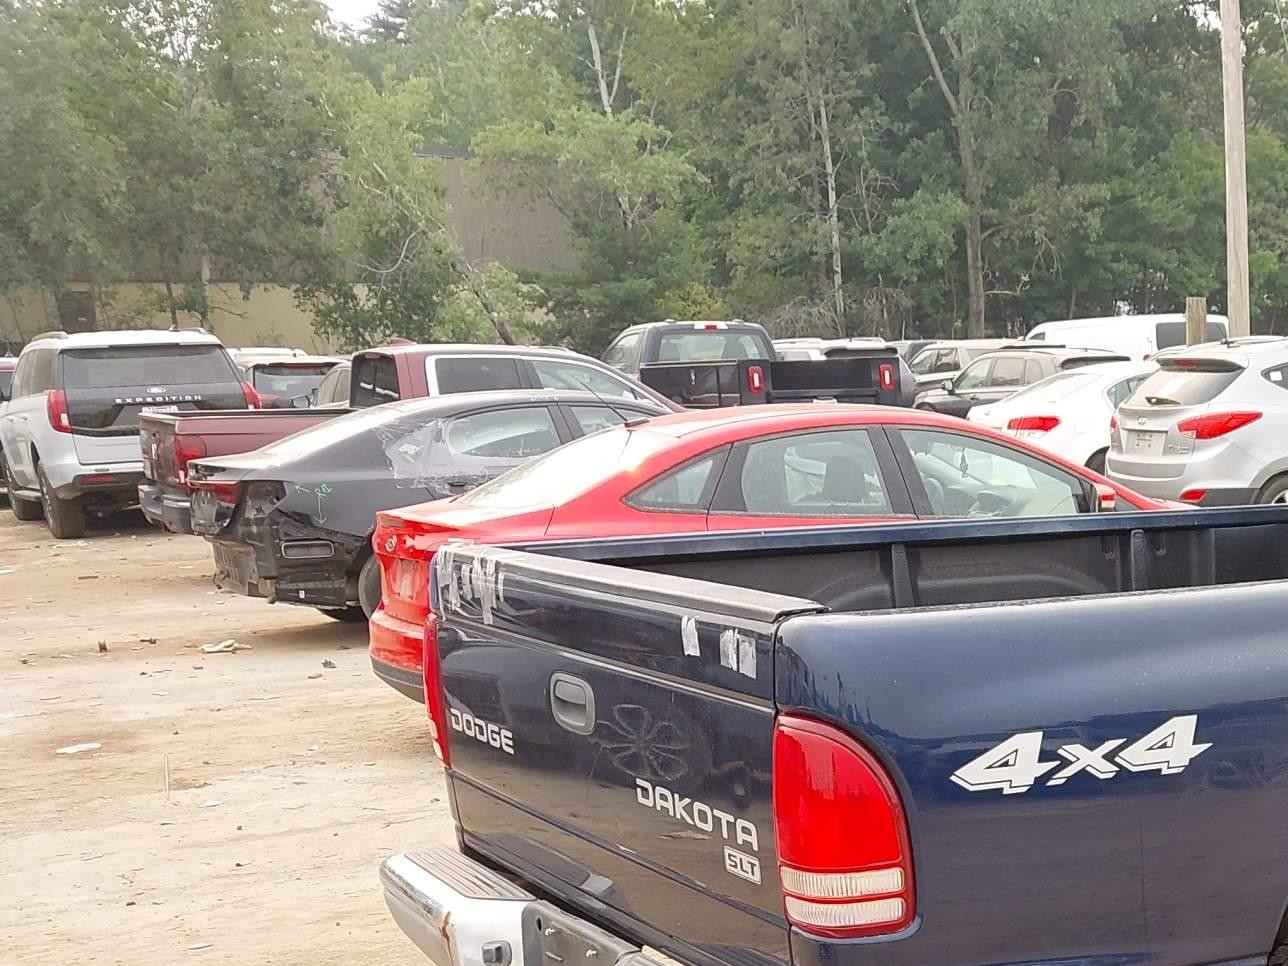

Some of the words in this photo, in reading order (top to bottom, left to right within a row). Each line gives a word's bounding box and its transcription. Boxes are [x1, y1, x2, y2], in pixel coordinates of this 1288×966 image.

[114, 394, 203, 404] EXPEDITION
[450, 707, 515, 755] DODGE
[950, 714, 1213, 794] 4x4
[635, 777, 759, 852] DAKOTA
[726, 851, 759, 879] SLT
